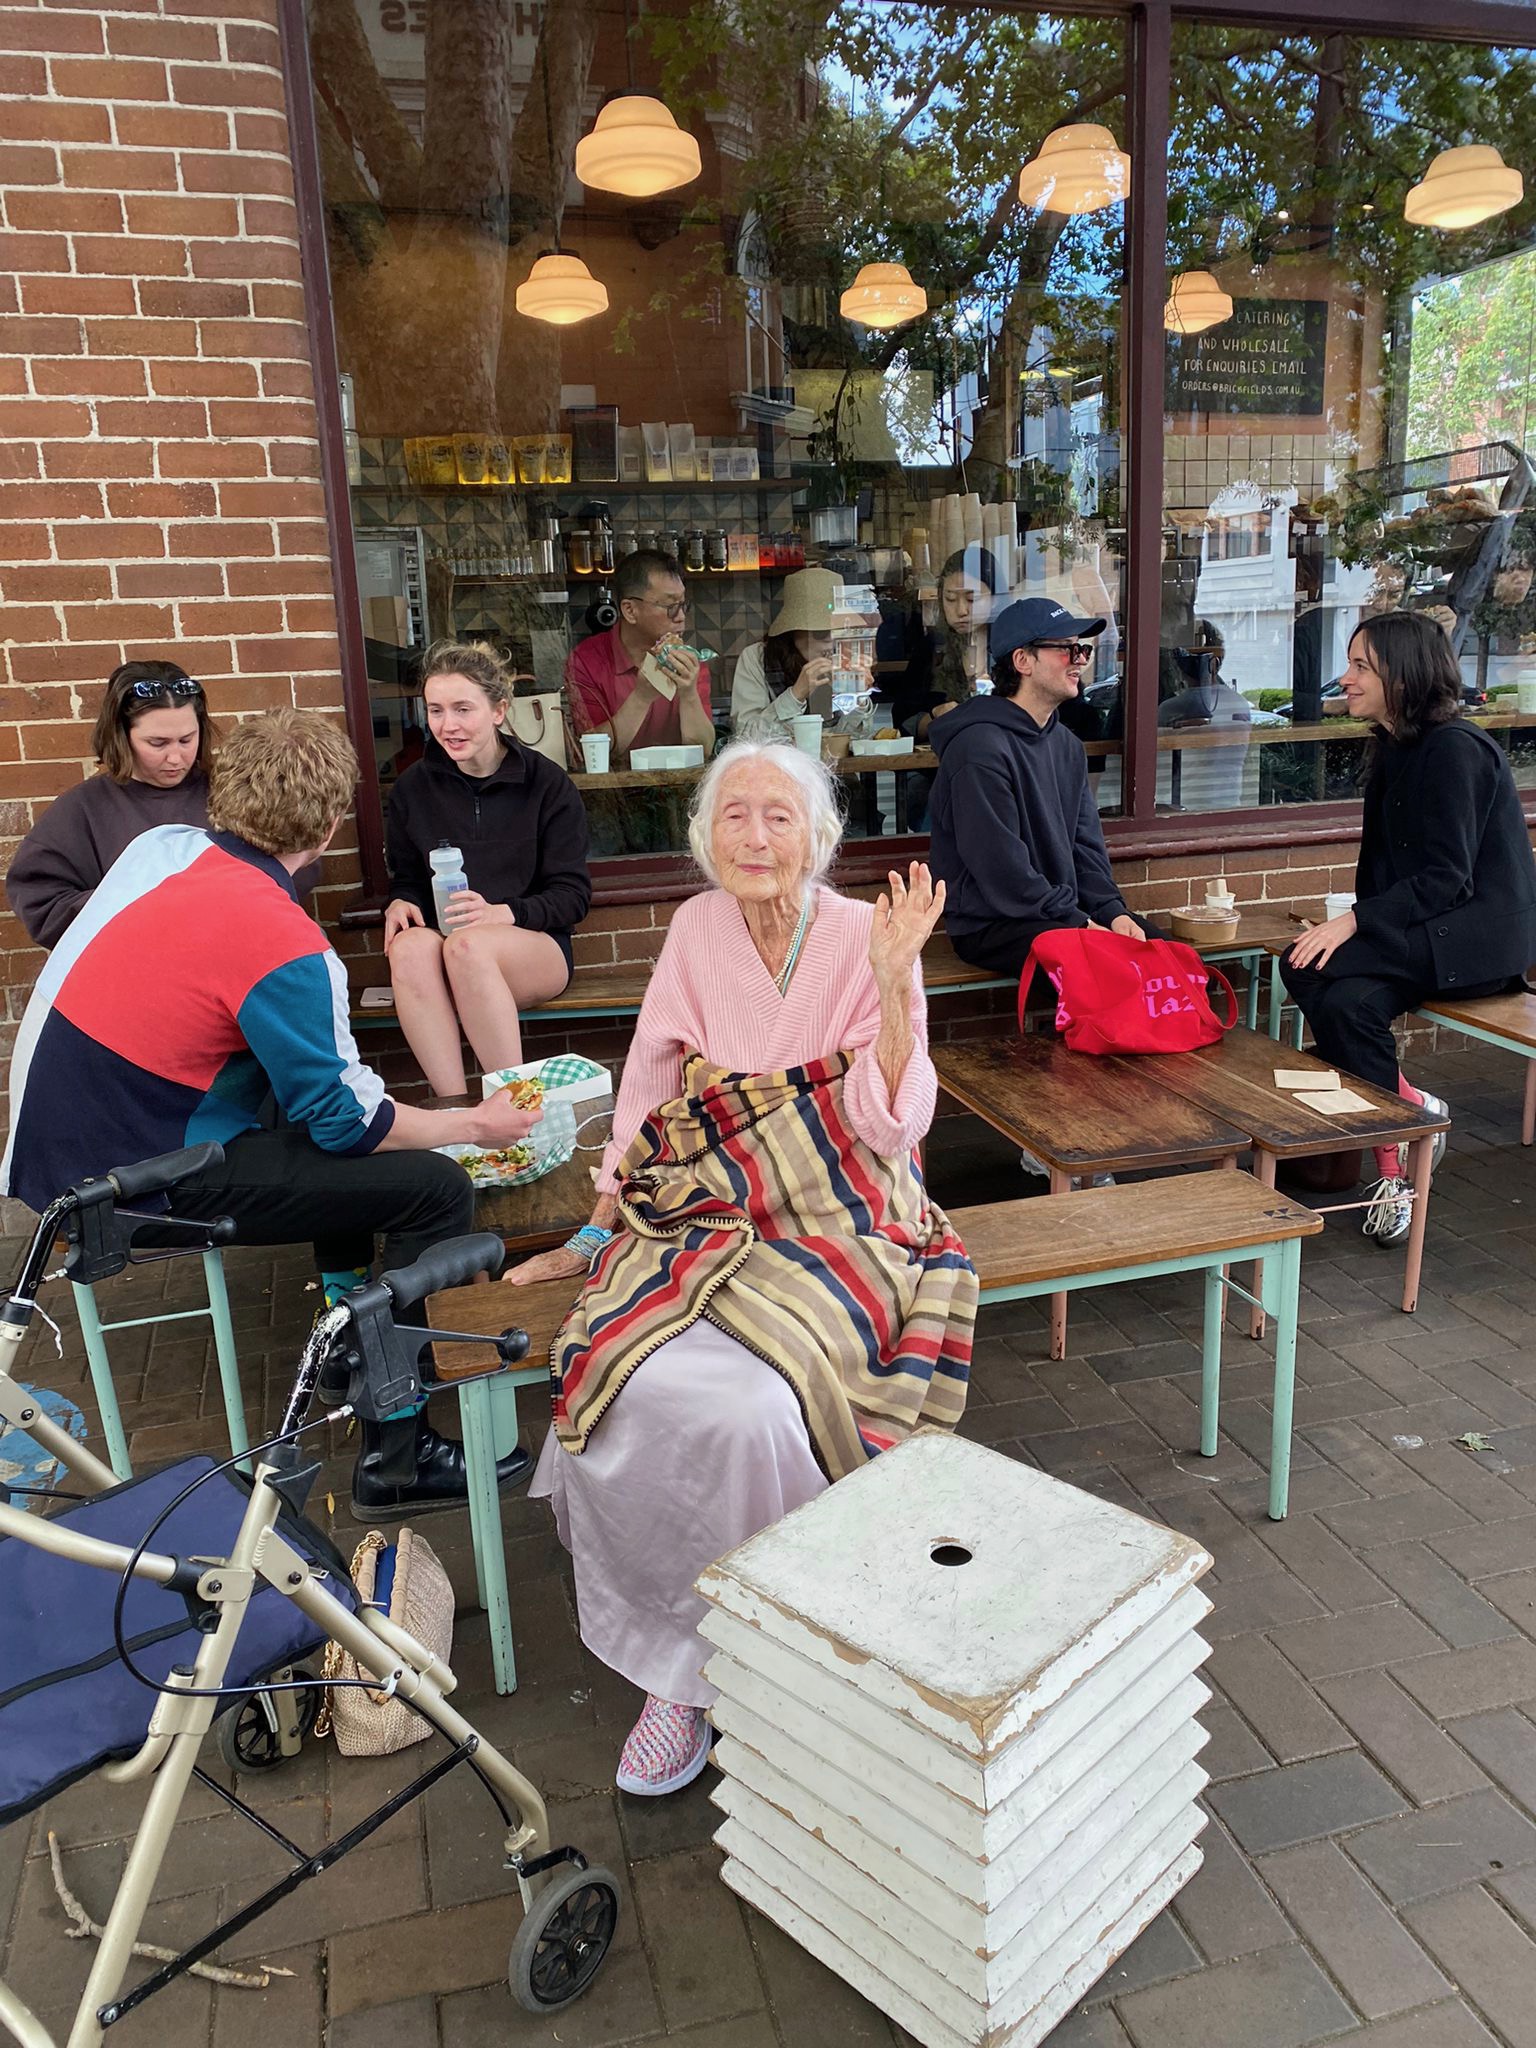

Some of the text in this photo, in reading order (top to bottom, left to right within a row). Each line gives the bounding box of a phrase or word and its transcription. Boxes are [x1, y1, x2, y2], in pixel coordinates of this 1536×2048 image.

[1236, 311, 1290, 326] CATERING
[1198, 337, 1217, 350] AND
[1184, 359, 1307, 375] FOR ENQUIRIES EMAIL
